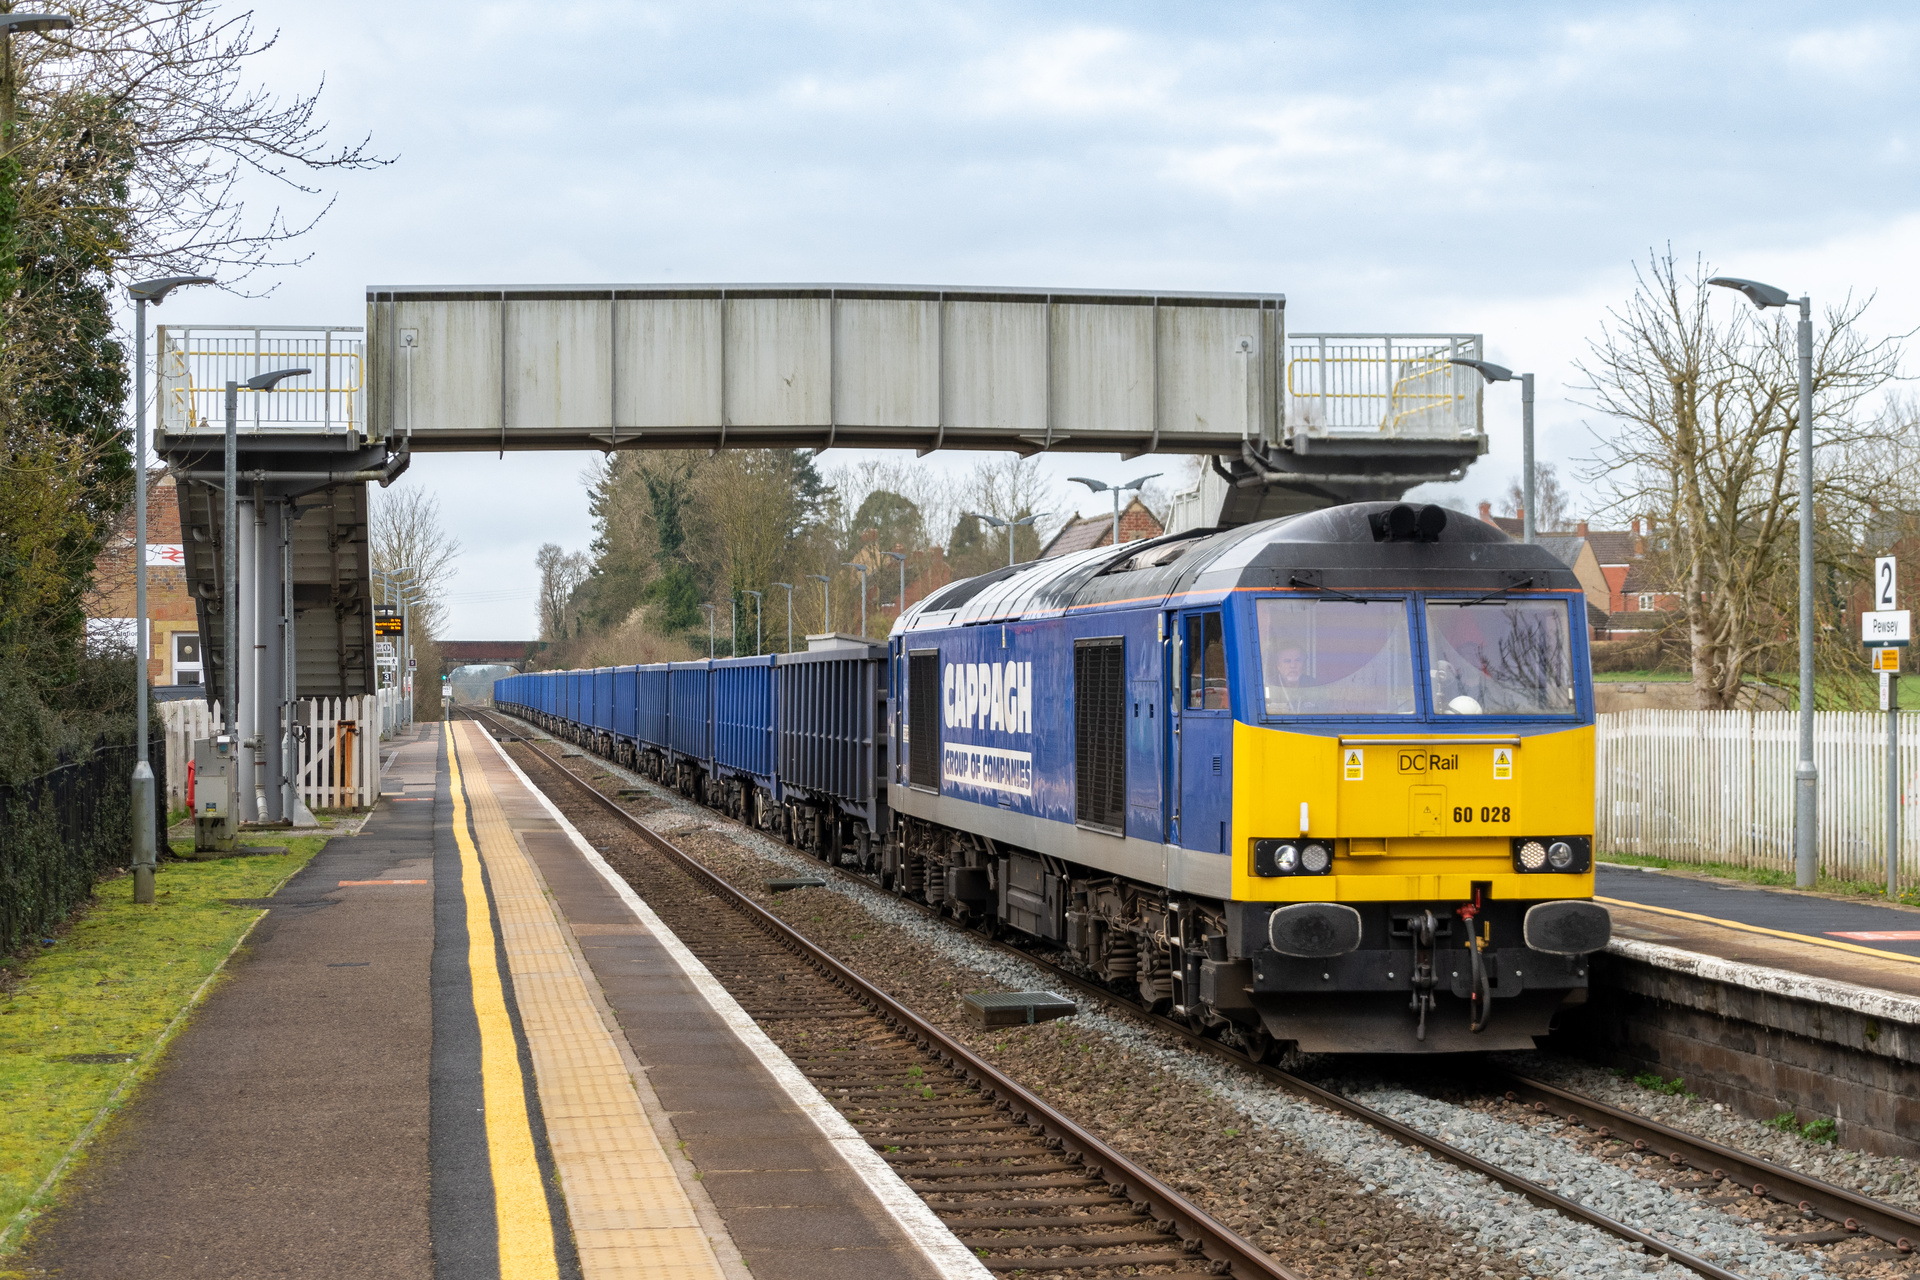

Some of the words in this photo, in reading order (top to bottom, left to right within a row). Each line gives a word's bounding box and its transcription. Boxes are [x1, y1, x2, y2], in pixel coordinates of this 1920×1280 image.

[1881, 562, 1892, 604] 2
[1873, 618, 1899, 636] Pewsey
[944, 661, 1032, 734] CAPPAGH
[945, 749, 969, 777] GROUP
[971, 752, 981, 780] OF
[983, 754, 1031, 790] COMPANIES
[1400, 754, 1425, 771] DC
[1429, 754, 1459, 770] Rail
[1453, 806, 1473, 823] 60
[1481, 806, 1511, 823] 028
